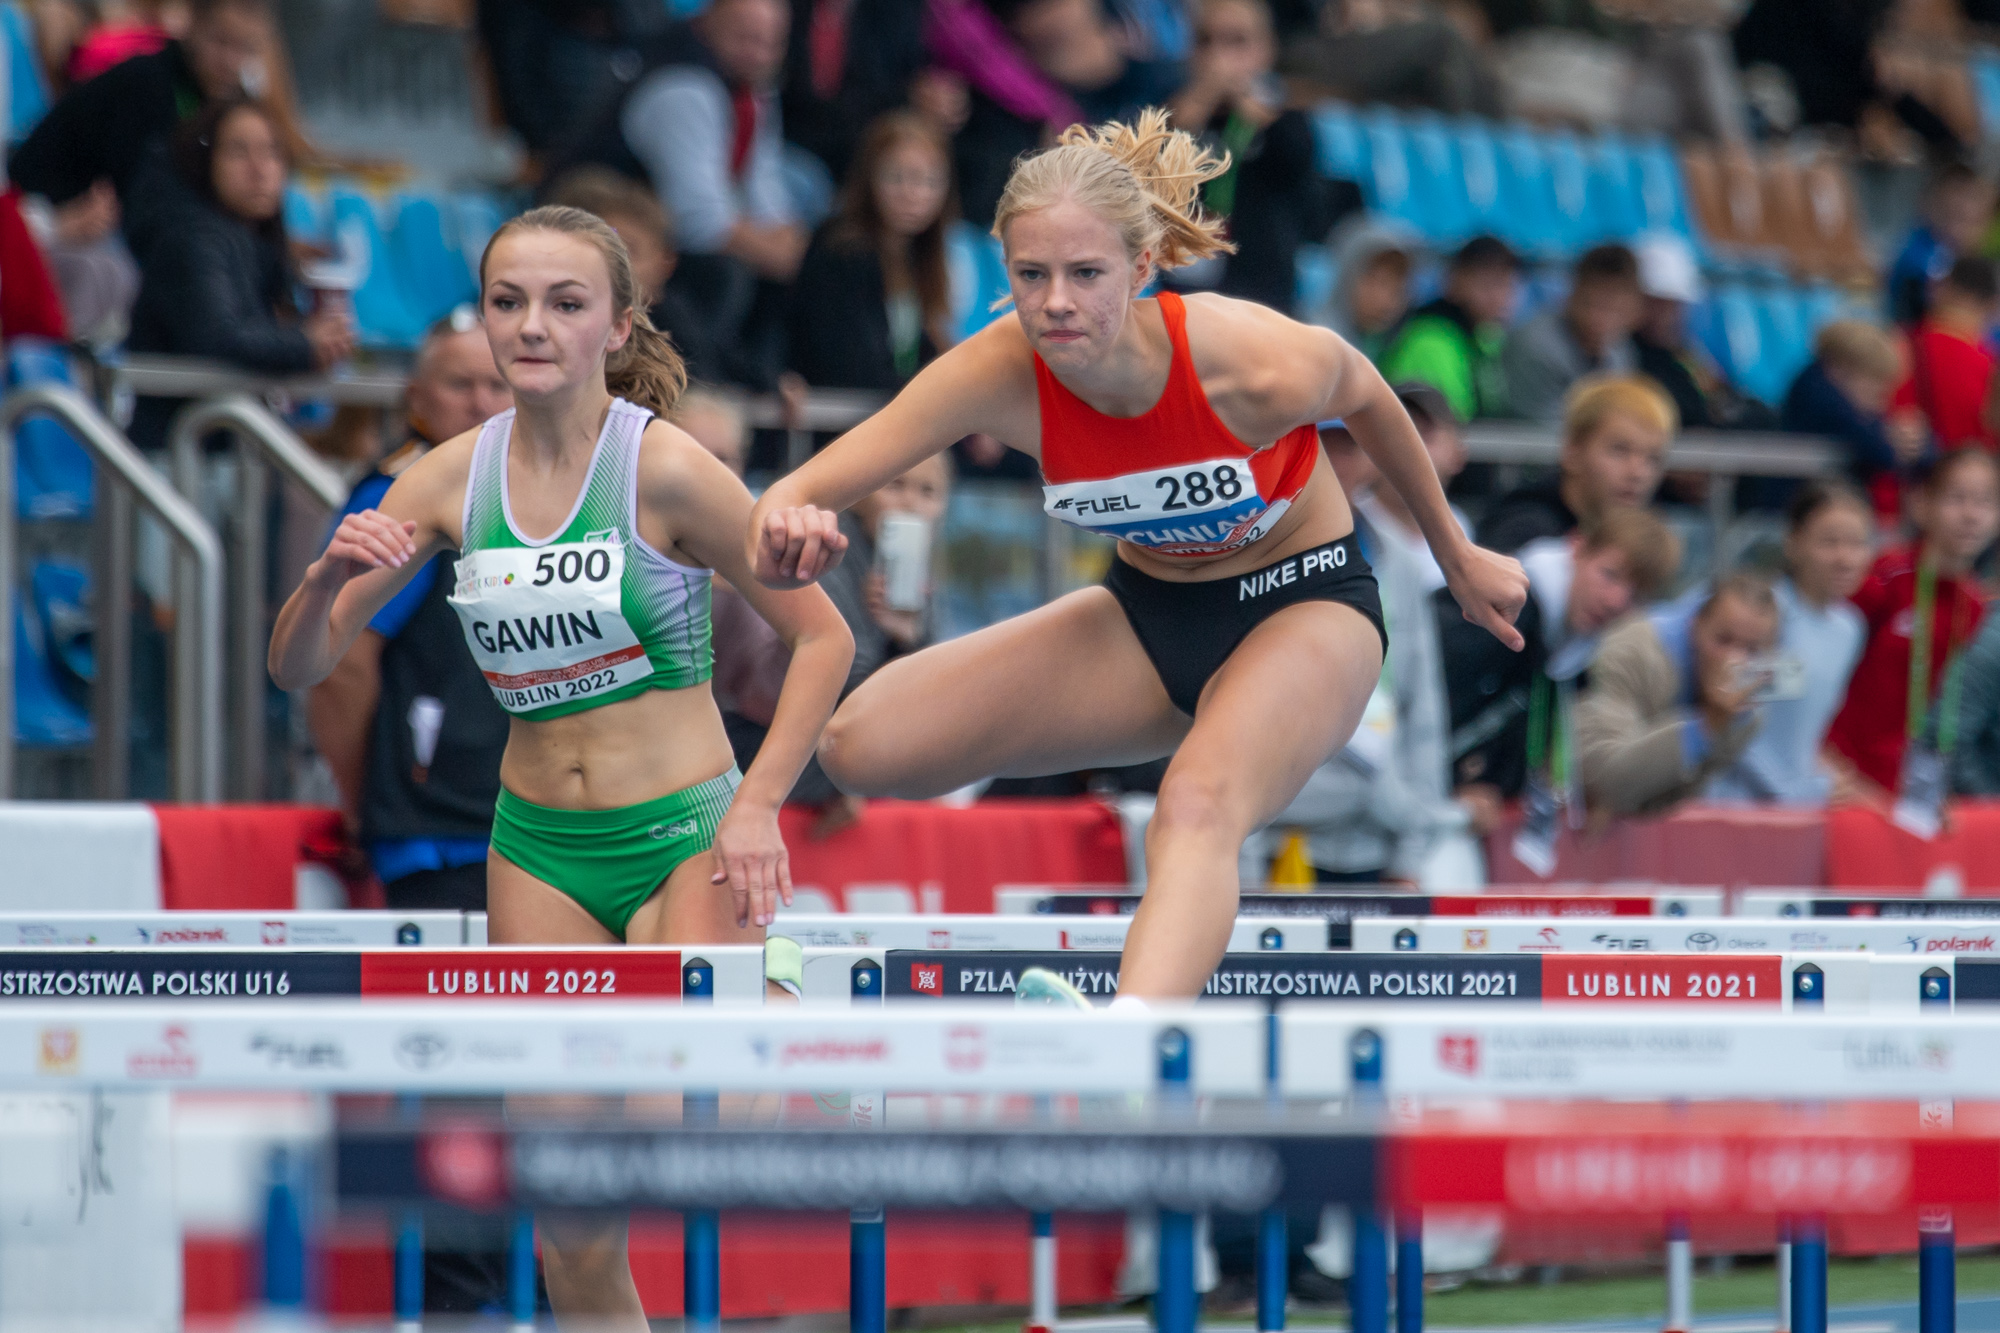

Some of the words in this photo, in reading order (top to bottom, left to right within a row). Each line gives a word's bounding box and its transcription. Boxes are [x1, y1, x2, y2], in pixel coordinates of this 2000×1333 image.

[1155, 465, 1242, 511] 288
[1075, 495, 1141, 516] FUEL
[532, 549, 611, 587] 500
[1239, 562, 1297, 601] NIKE
[1303, 546, 1346, 577] PRO
[472, 610, 603, 654] GAWIN
[499, 684, 561, 708] LUBLIN
[565, 669, 618, 697] 2022
[1925, 936, 1996, 954] polanik
[152, 972, 236, 995] POLSKI
[245, 972, 290, 995] U16
[427, 971, 529, 994] LUBLIN
[544, 971, 616, 994] 2022
[960, 971, 1017, 992] PZLA
[1369, 973, 1454, 995] POLSKI
[1461, 973, 1517, 996] 2021
[1567, 974, 1671, 997] LUBLIN
[1686, 974, 1756, 997] 2021
